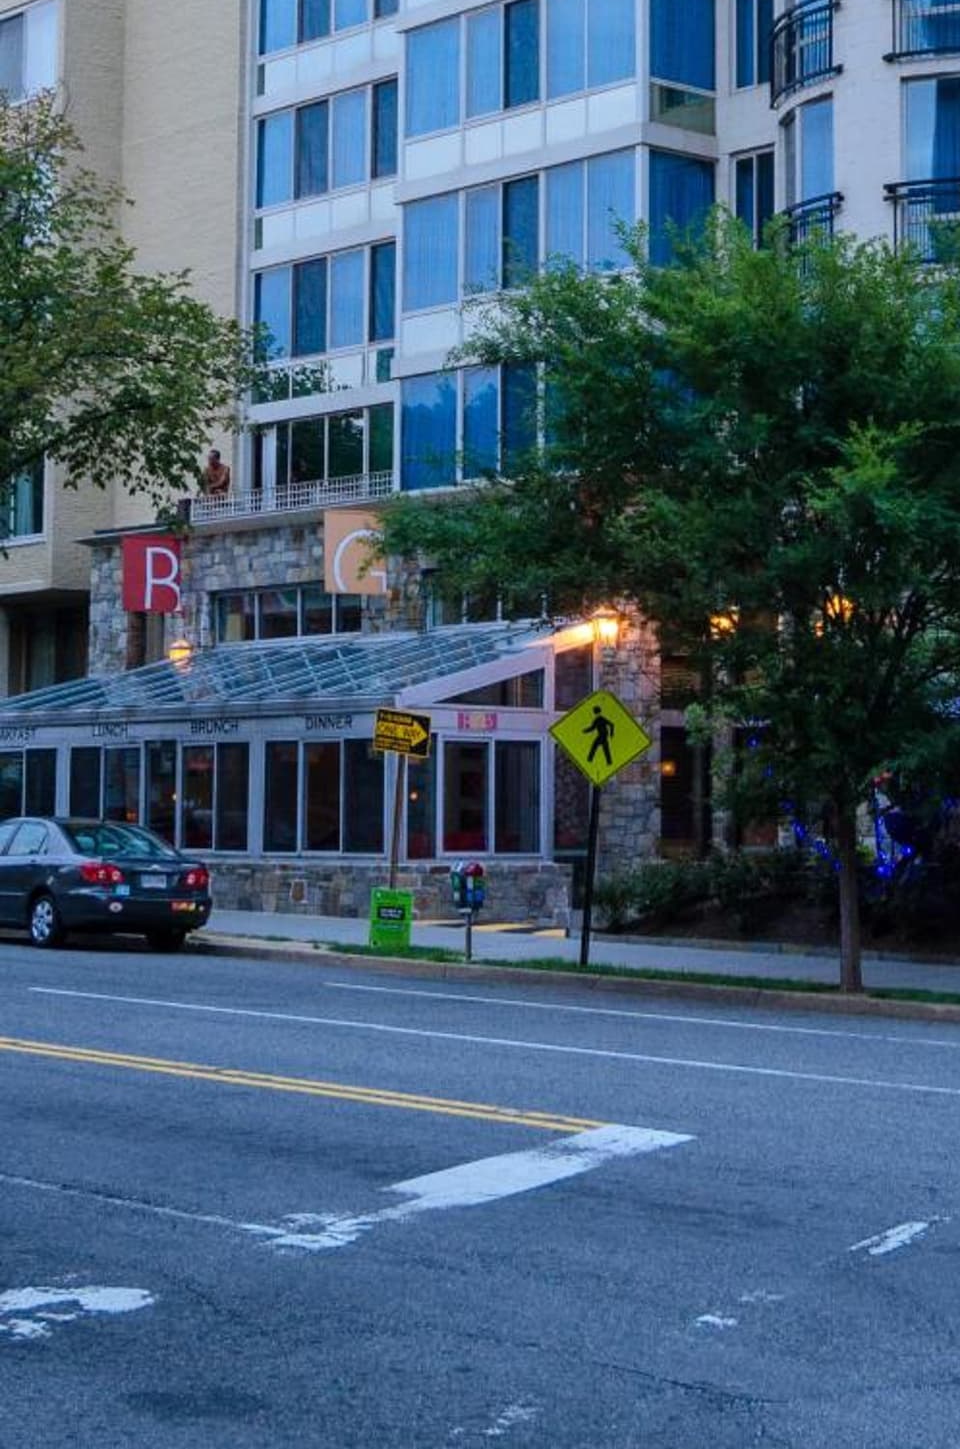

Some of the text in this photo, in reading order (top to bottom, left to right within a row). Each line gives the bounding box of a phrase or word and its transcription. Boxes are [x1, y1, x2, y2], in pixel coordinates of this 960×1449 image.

[92, 722, 129, 739] LUNCH
[190, 719, 238, 735] BRUNCH
[304, 714, 353, 731] DINNER
